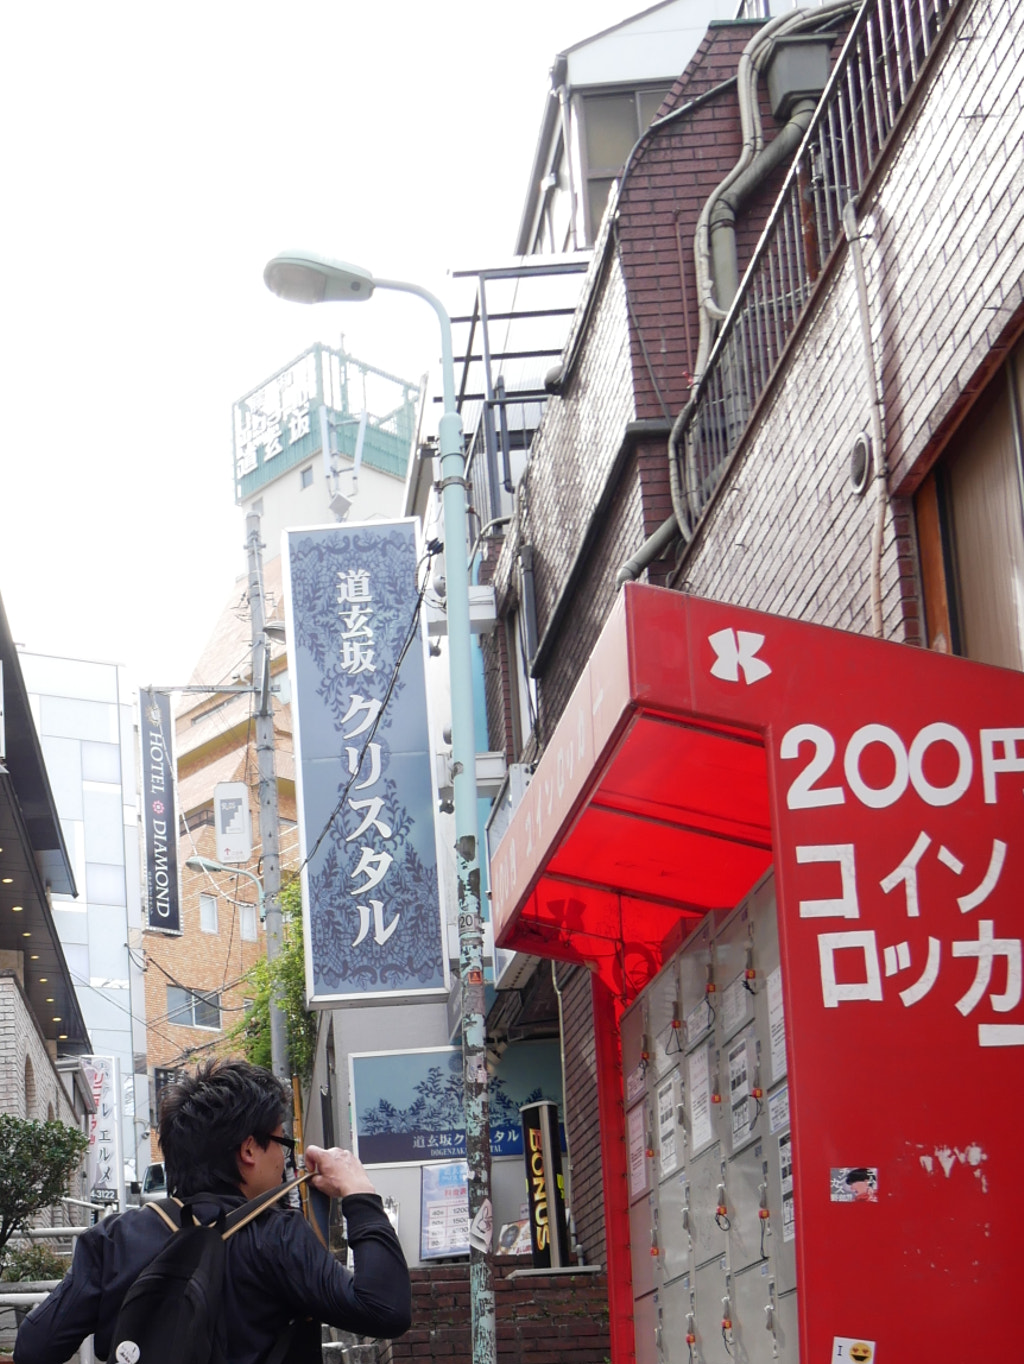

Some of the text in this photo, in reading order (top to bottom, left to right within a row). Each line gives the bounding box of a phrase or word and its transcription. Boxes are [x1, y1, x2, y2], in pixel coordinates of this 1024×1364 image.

[337, 568, 400, 948] 道玄坂 クリスタル
[779, 722, 1024, 811] 200円
[149, 731, 170, 919] HOTEL DIAMOND
[795, 830, 1008, 915] コイン
[529, 1128, 551, 1251] BONUS
